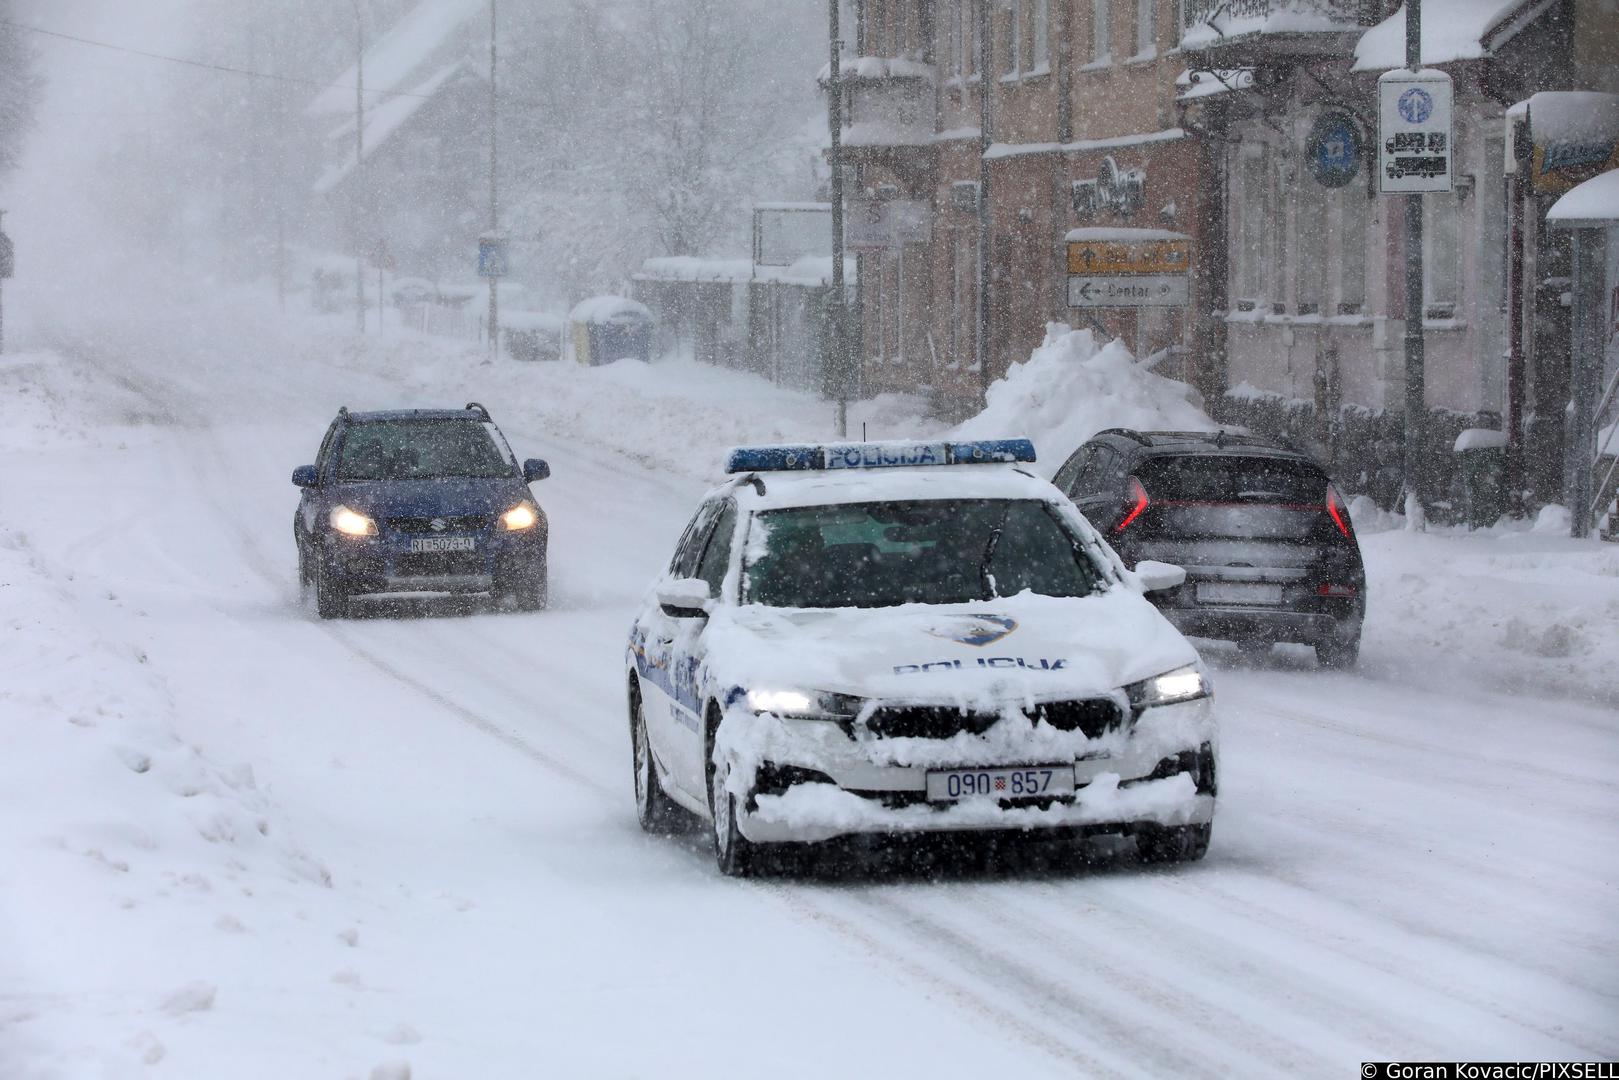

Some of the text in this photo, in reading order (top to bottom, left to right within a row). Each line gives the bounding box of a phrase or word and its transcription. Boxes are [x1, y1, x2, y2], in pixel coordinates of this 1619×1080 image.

[413, 539, 424, 551] RI
[948, 770, 1053, 797] 090 857
